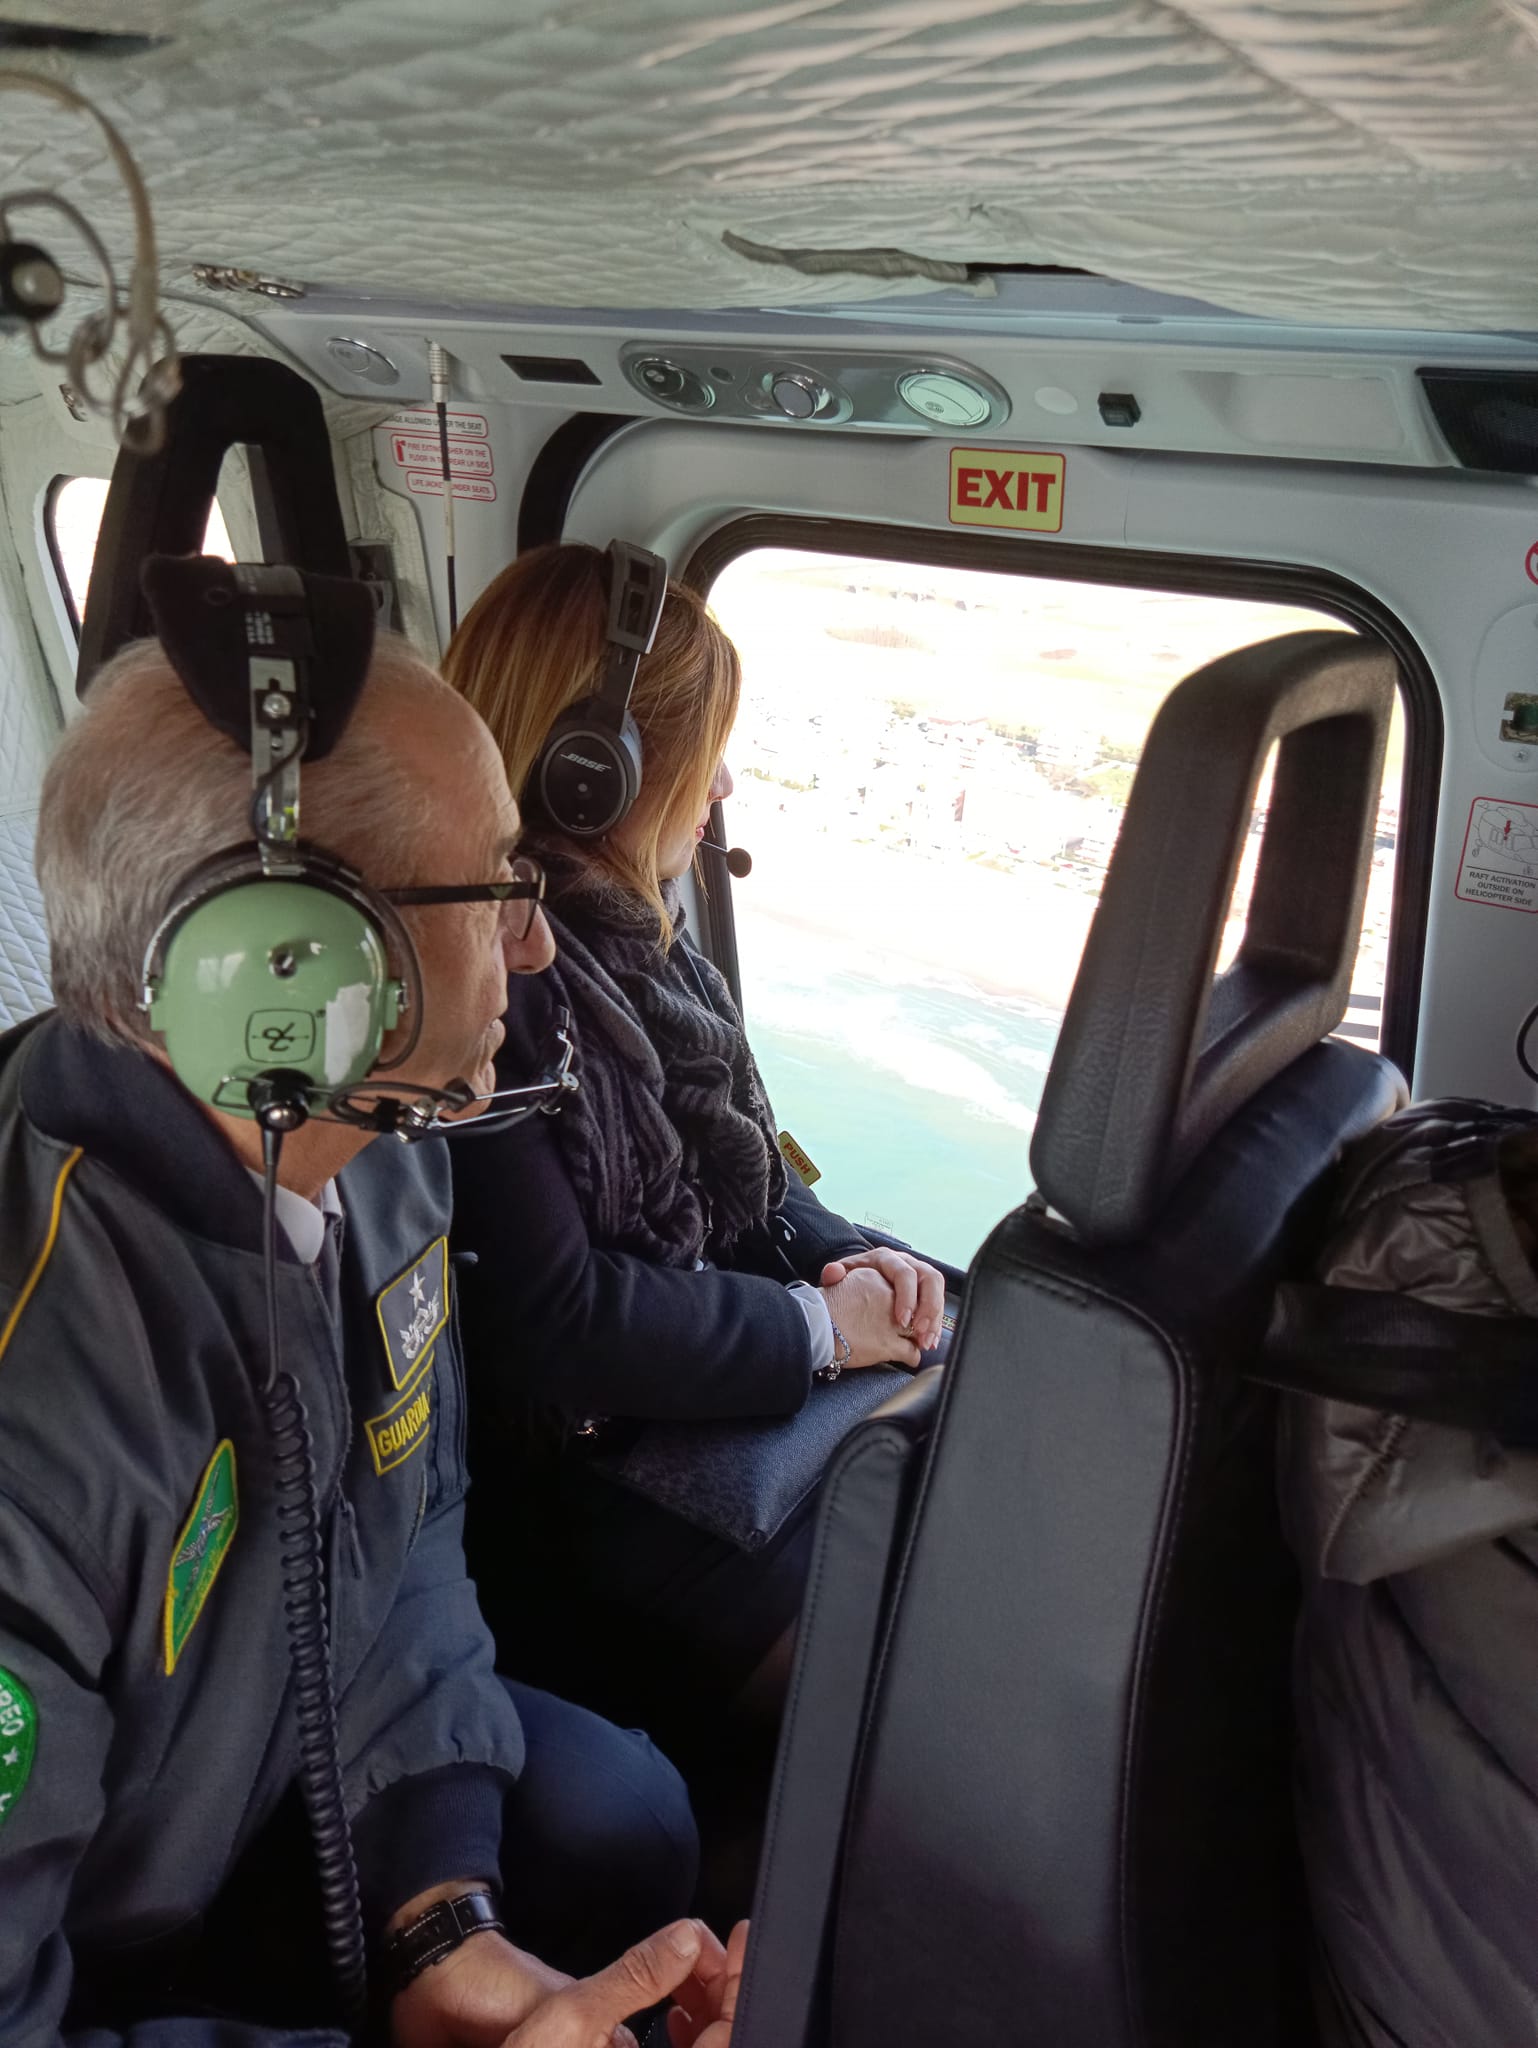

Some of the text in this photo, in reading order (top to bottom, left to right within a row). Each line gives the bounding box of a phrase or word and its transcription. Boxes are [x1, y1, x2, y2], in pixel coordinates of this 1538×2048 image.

[408, 442, 420, 450] FIRE
[412, 479, 424, 487] LIFE
[957, 467, 1056, 513] EXIT
[560, 753, 612, 773] BOSE
[1469, 871, 1536, 888] RAFT ACTIVATION
[1477, 881, 1525, 896] OUTSIDE ON
[1465, 888, 1533, 907] HELICOPTER SIDE
[784, 1142, 810, 1174] PUSH
